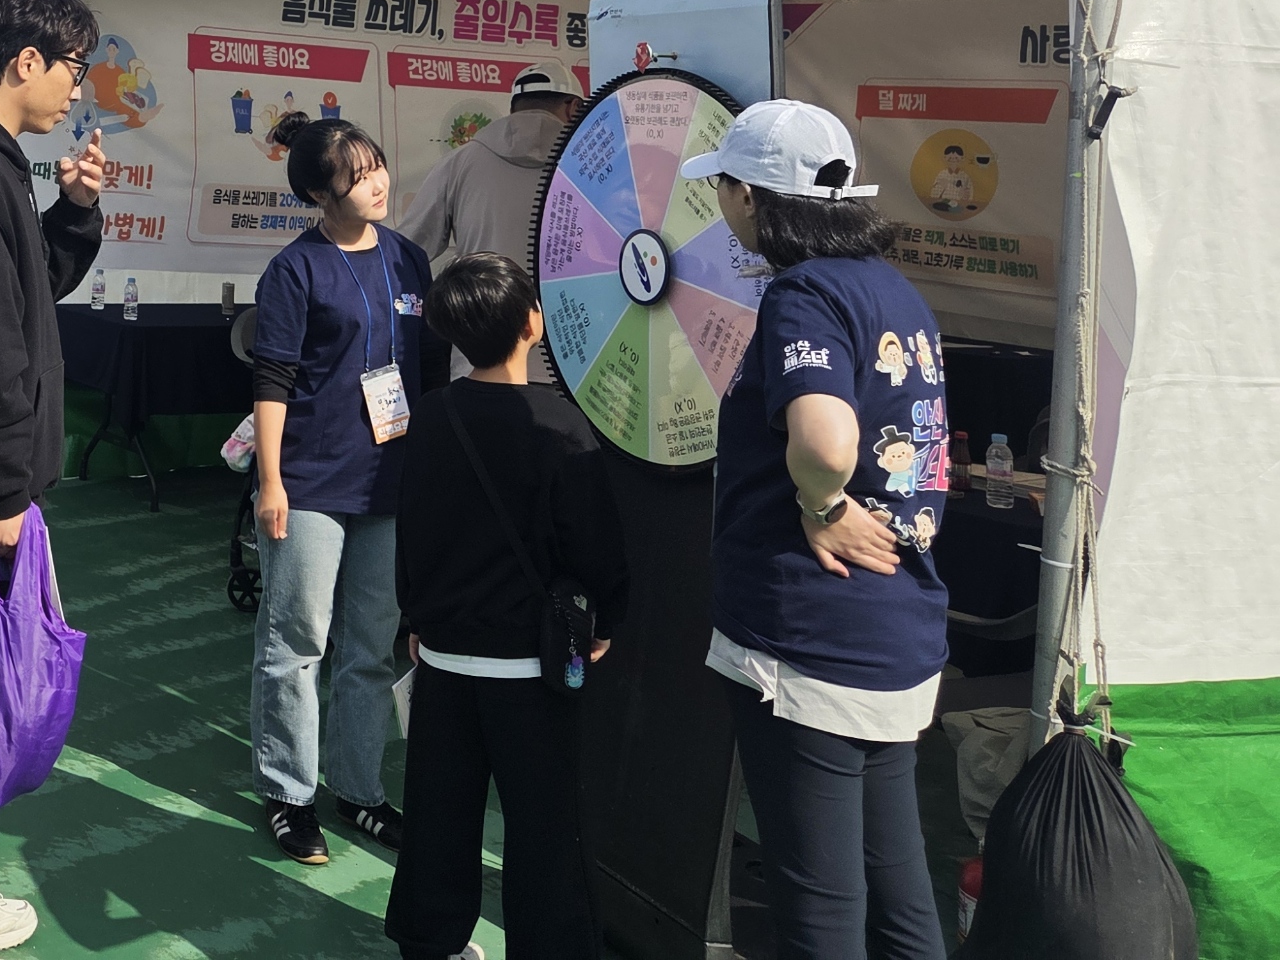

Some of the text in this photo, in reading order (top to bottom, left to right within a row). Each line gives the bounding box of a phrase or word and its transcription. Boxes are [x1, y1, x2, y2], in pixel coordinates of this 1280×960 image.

[210, 40, 310, 70] 경제에 좋아요
[408, 58, 502, 84] 건강에 좋아요
[634, 103, 679, 114] 유통기한을 넘기고
[878, 90, 926, 113] 덜 짜게
[235, 107, 249, 115] FULL
[623, 115, 645, 126] 오랫동안
[646, 116, 668, 126] 보관해도
[588, 151, 599, 166] 수입
[213, 188, 241, 206] 음식물
[242, 190, 277, 208] 쓰레기를
[231, 213, 259, 229] 달하는
[260, 214, 287, 230] 경제적
[555, 215, 563, 231] 집에
[544, 235, 552, 265] 식당에서
[548, 210, 556, 233] 식사를
[551, 233, 561, 256] 음식은
[900, 227, 922, 243] 물은
[949, 232, 977, 250] 소스는
[565, 239, 574, 263] 줄이는
[549, 257, 557, 273] 남은
[923, 251, 964, 270] 고춧가루
[999, 260, 1038, 280] 사용하기
[556, 308, 565, 323] 식단
[783, 340, 810, 356] 안산
[783, 347, 829, 370] 페스타
[678, 411, 702, 427] 권장량은
[665, 432, 678, 445] 소금
[688, 423, 713, 439] 한국인의
[668, 439, 715, 457] WHO에서 규정한
